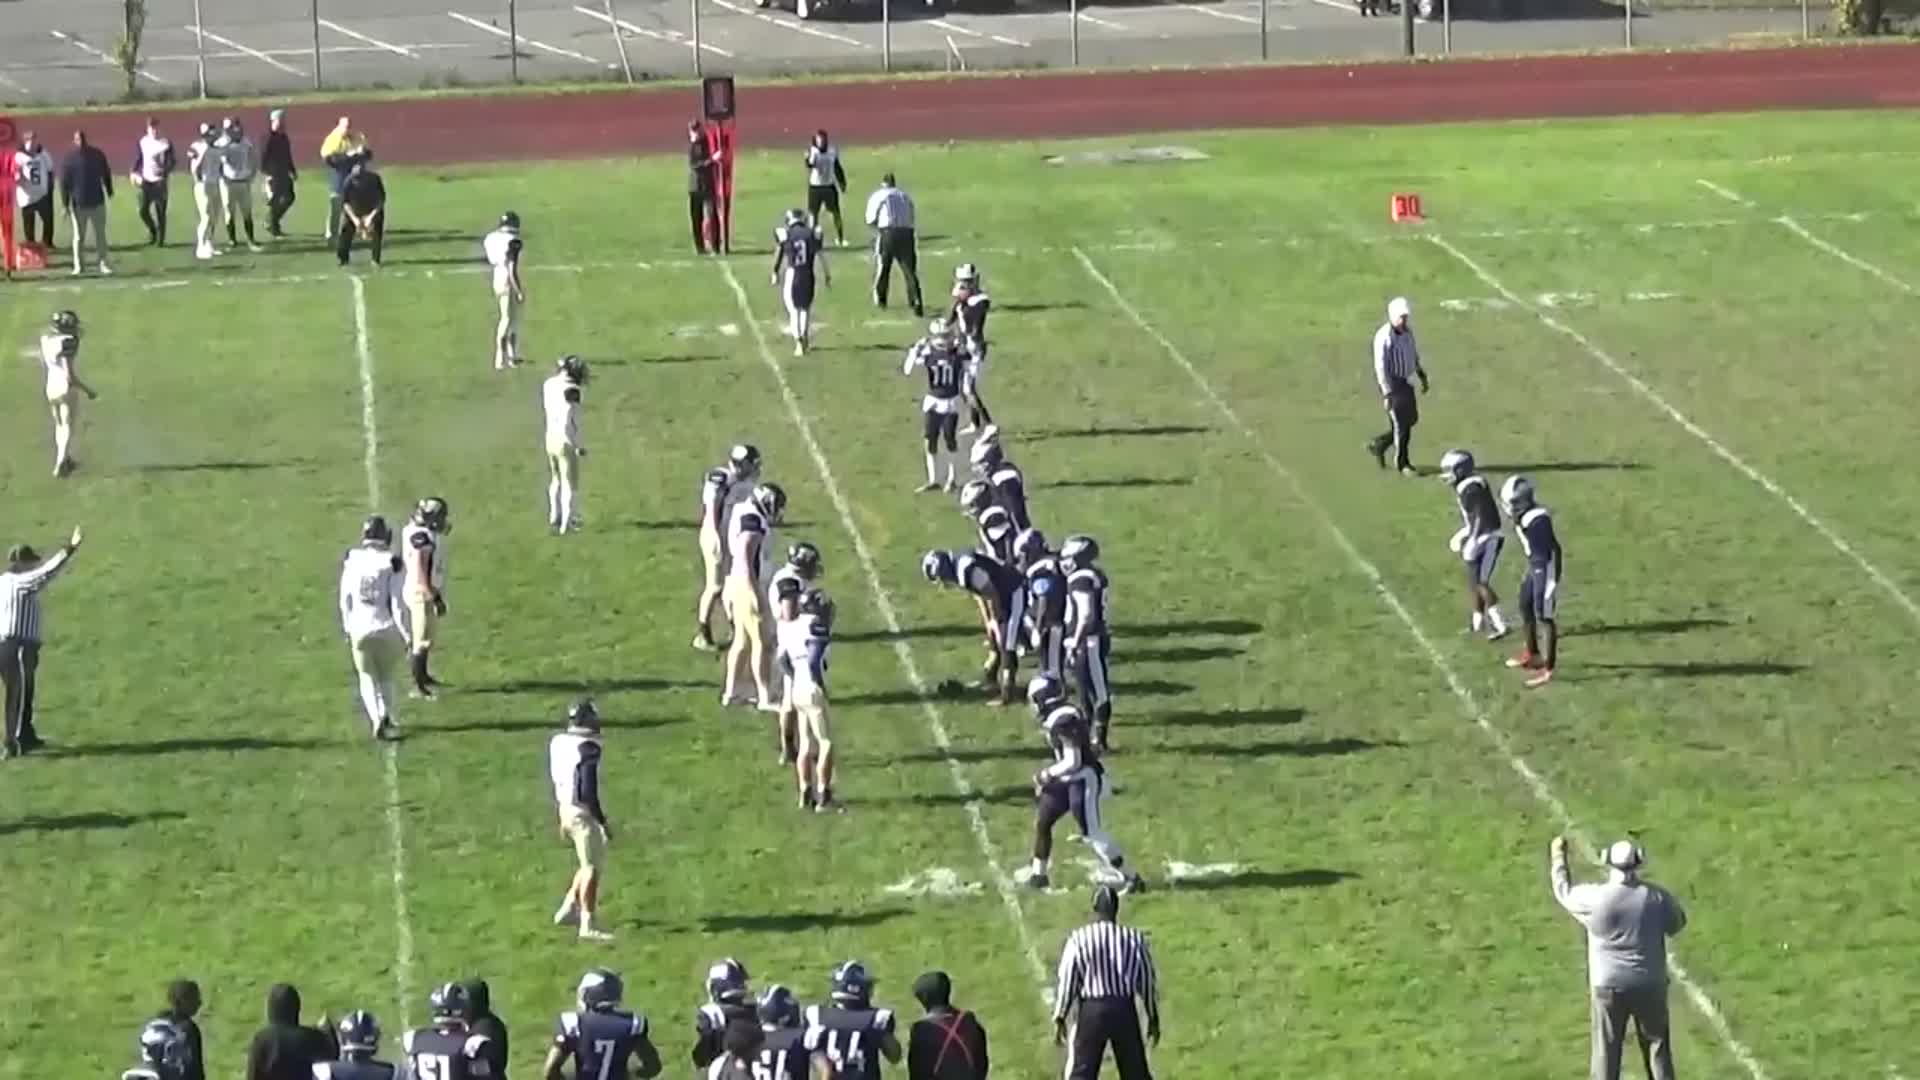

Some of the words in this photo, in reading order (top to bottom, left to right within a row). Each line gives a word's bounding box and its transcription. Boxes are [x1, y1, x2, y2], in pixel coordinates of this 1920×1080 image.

[1396, 195, 1419, 216] 30
[793, 239, 807, 266] 3
[594, 1039, 616, 1080] 7
[827, 1029, 865, 1072] 44
